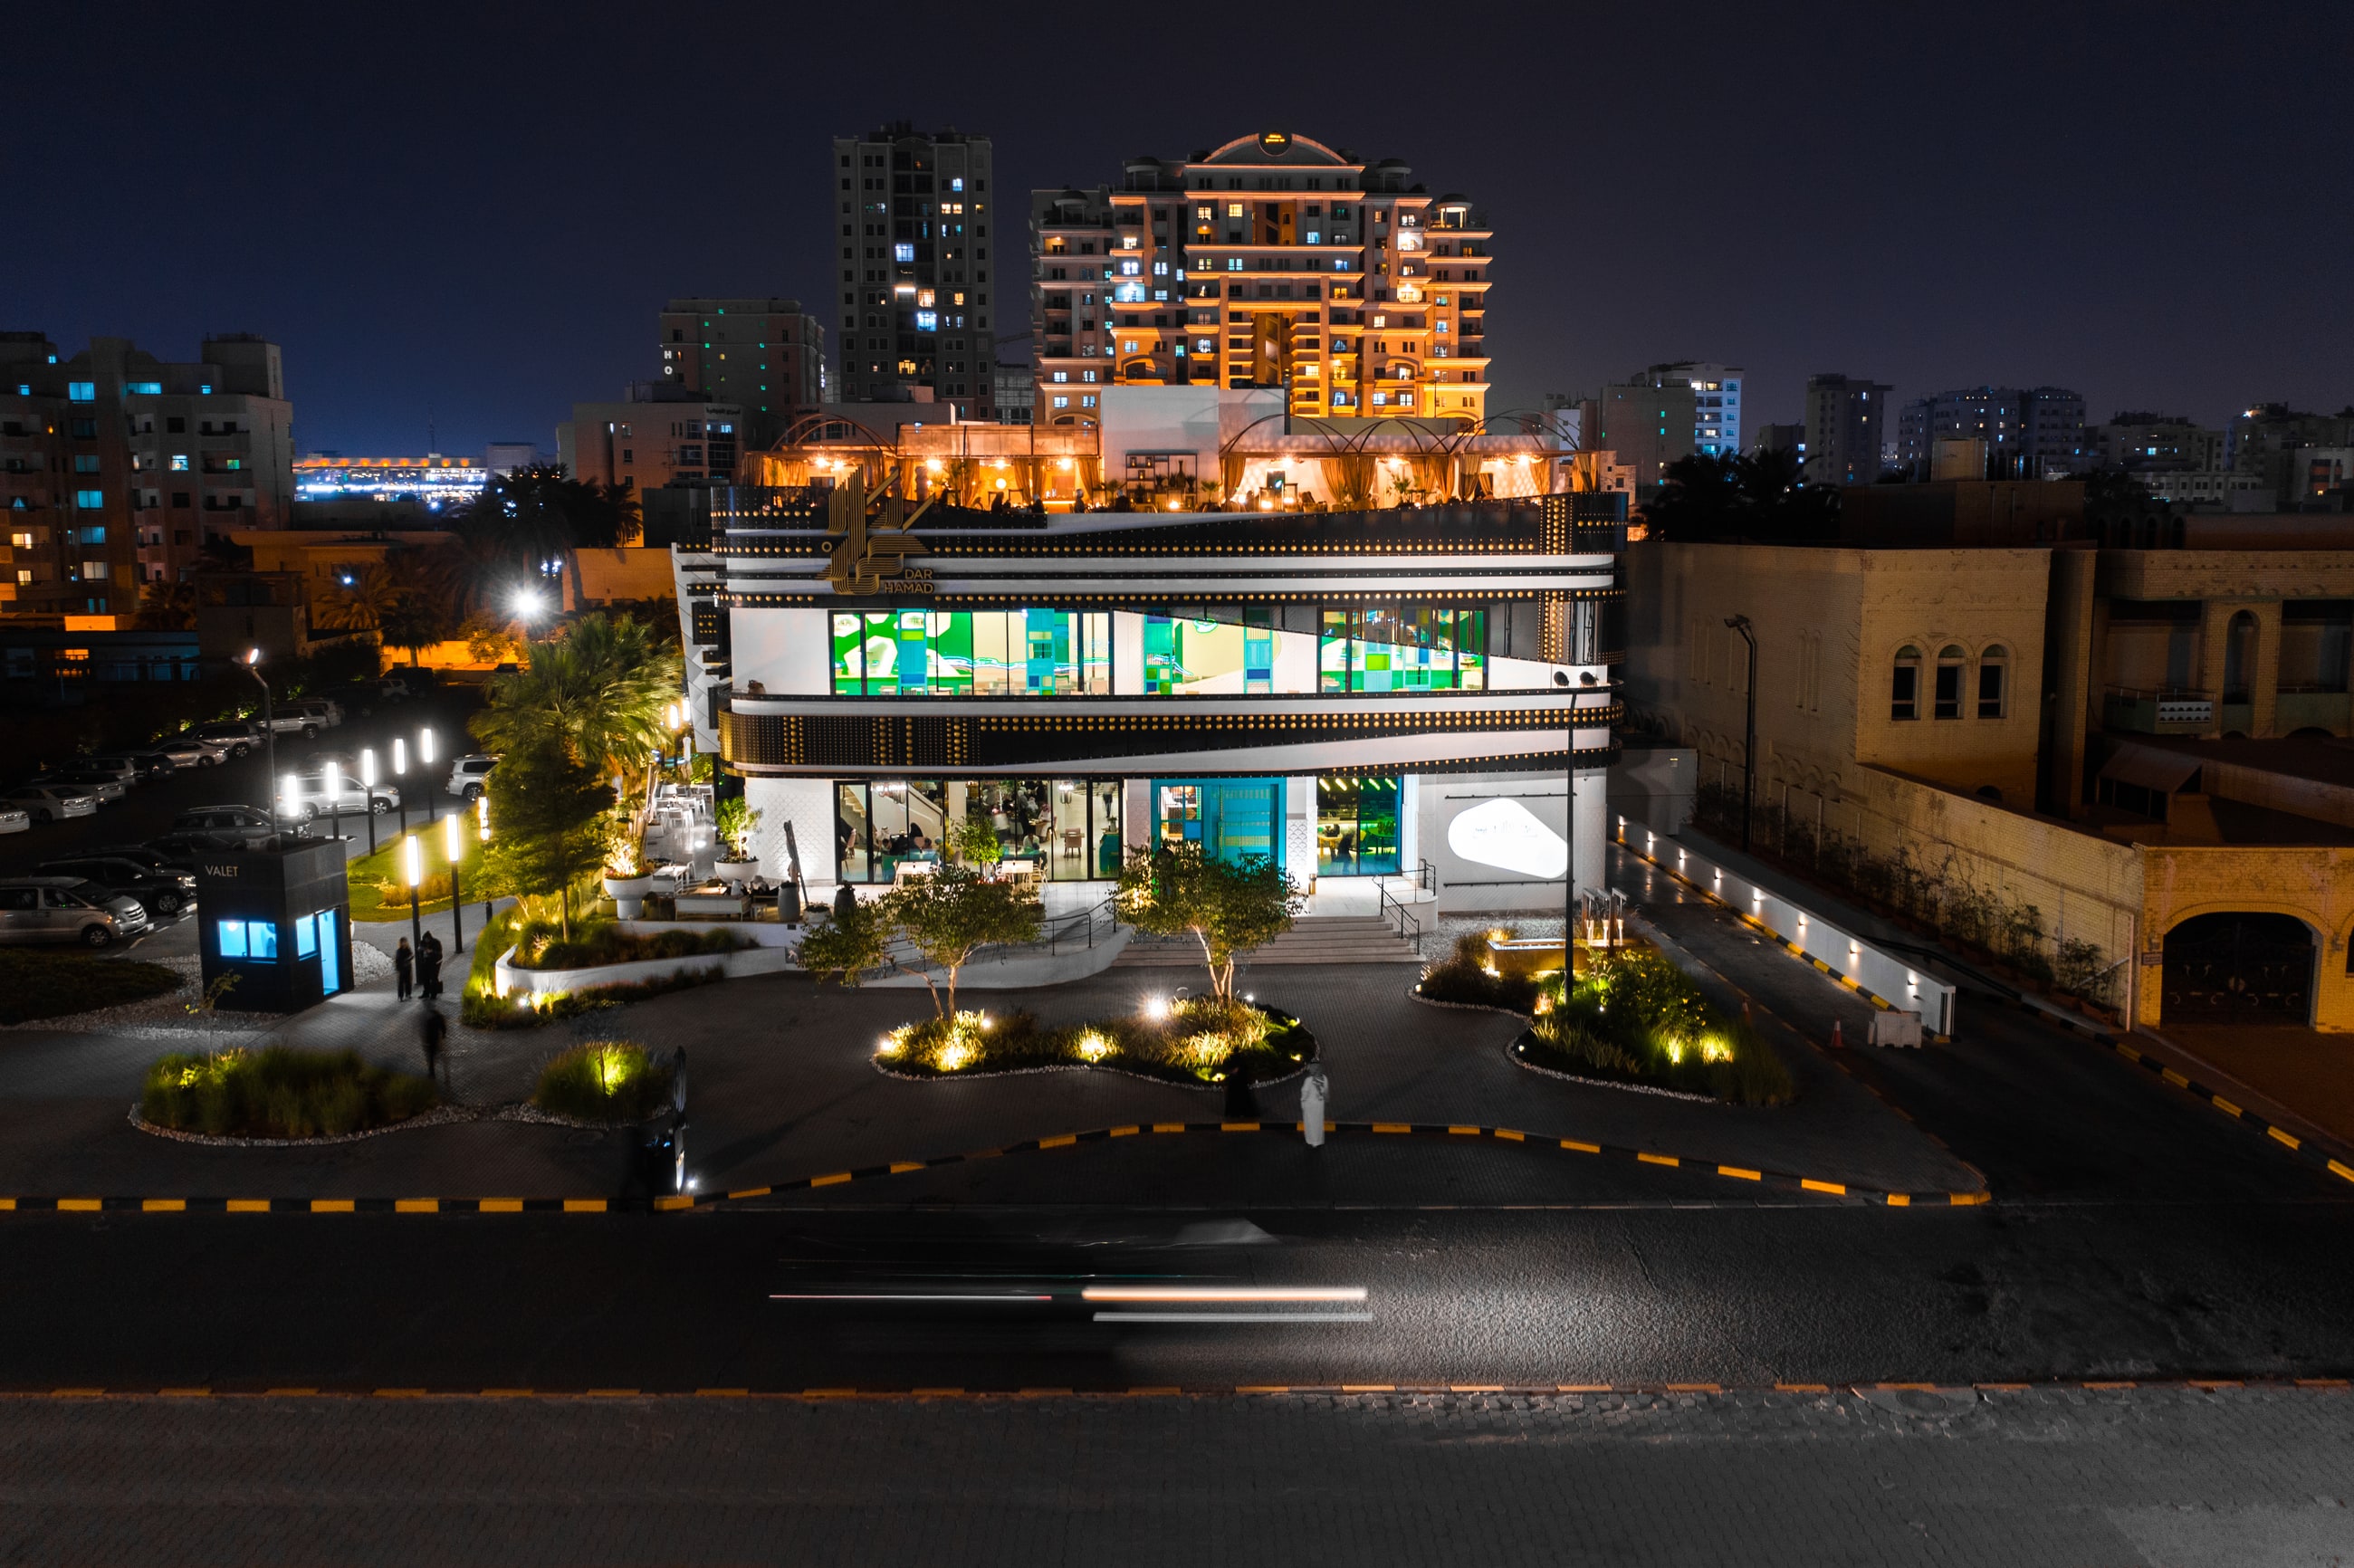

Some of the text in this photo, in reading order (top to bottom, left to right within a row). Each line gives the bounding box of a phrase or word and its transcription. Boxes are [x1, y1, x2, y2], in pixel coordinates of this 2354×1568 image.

[904, 569, 933, 579] DAR
[884, 582, 933, 595] HAMAD
[205, 865, 238, 877] VALET
